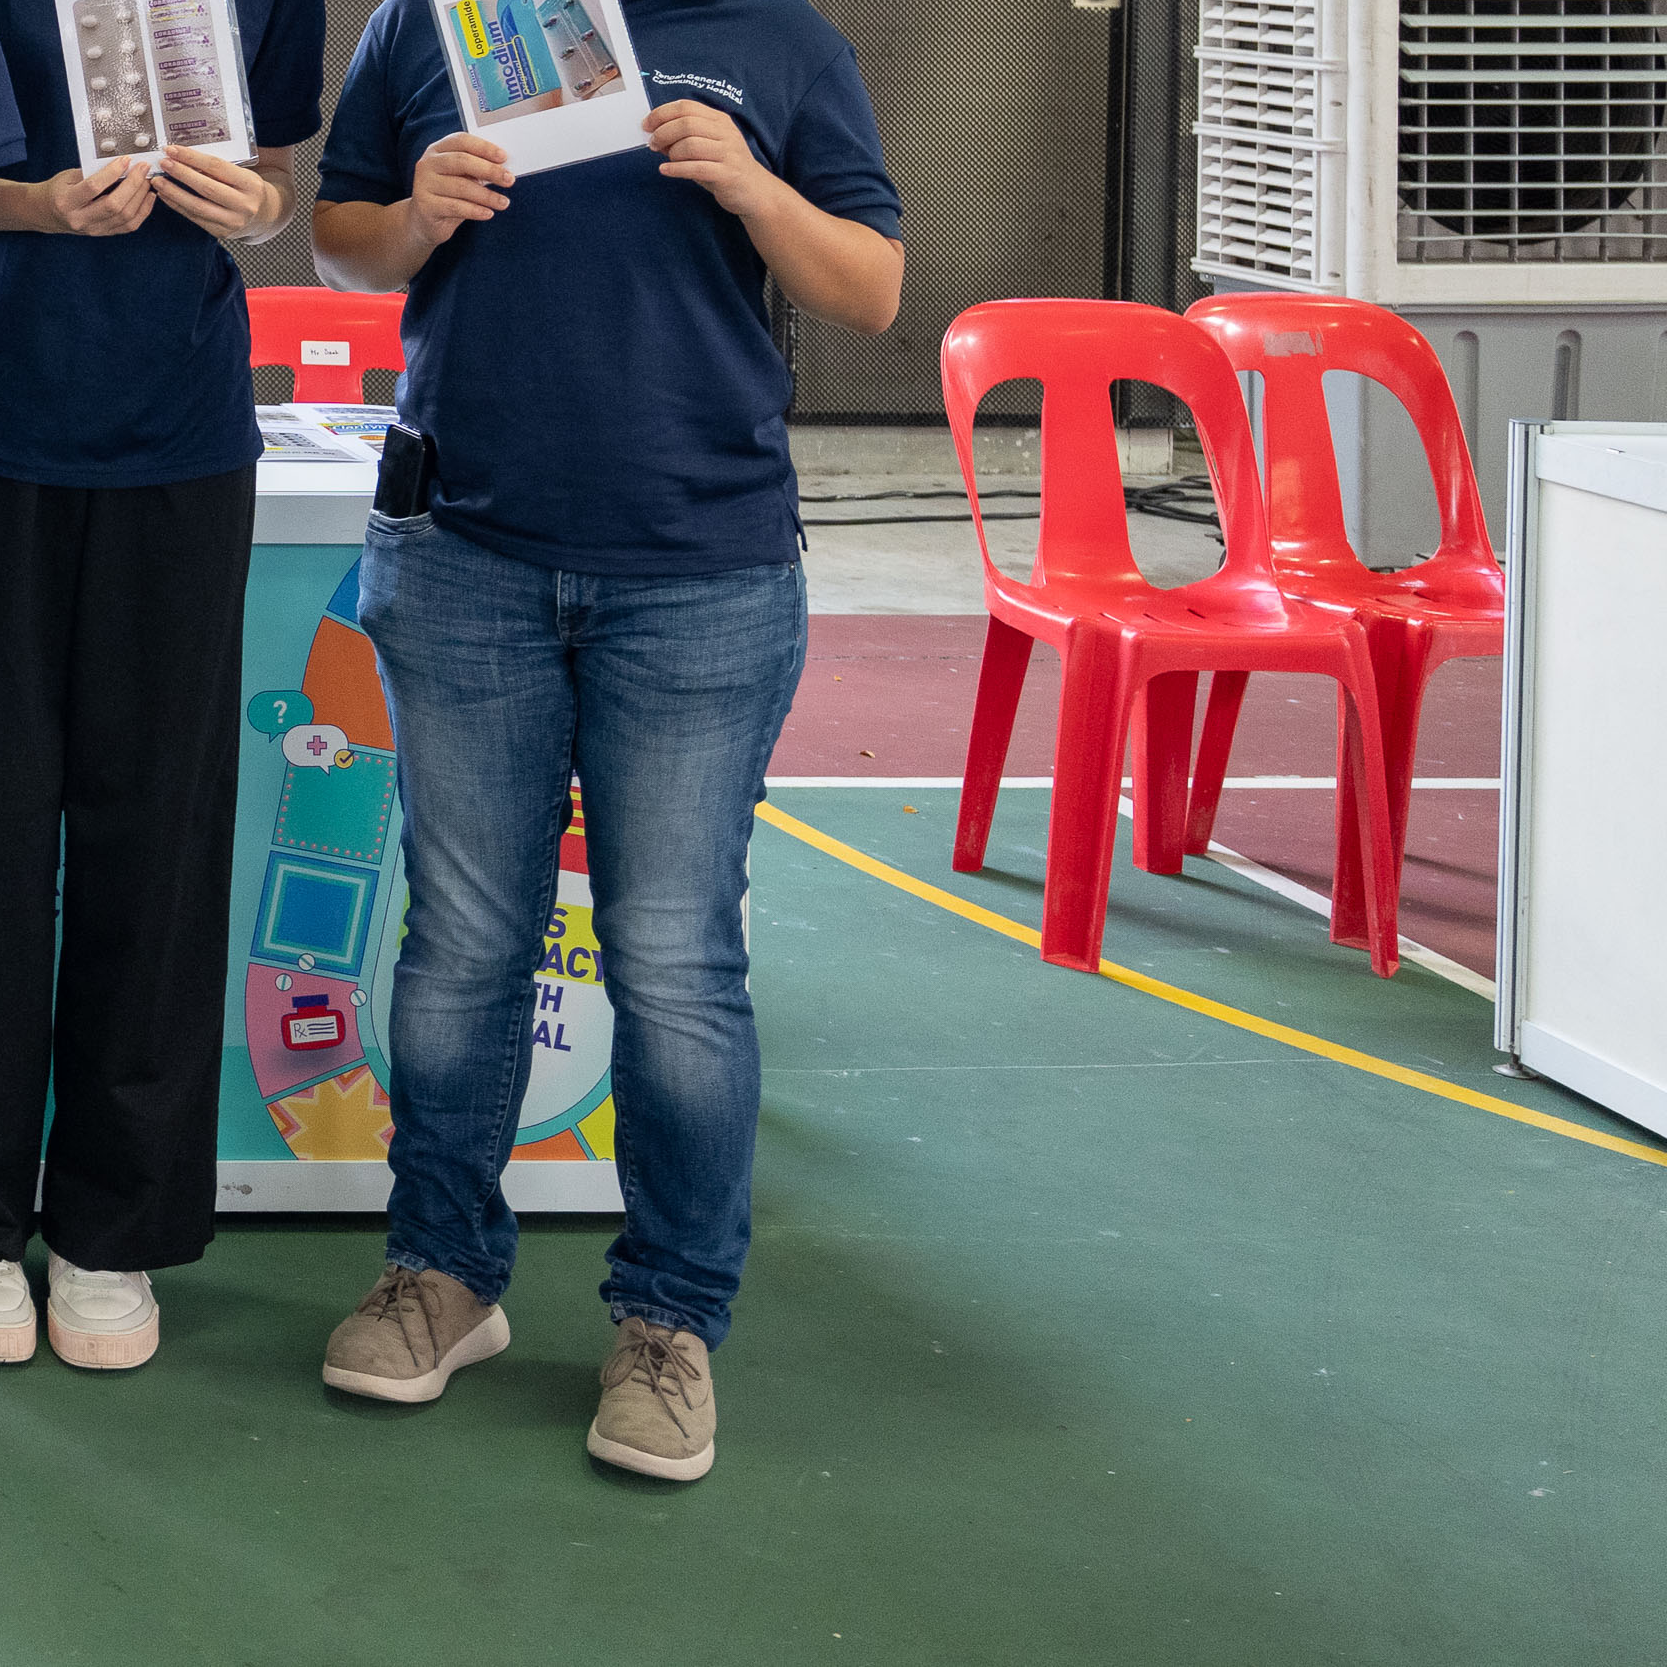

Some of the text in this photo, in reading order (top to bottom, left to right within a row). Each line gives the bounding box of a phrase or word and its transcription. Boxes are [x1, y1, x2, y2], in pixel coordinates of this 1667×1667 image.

[463, 1, 485, 56] Loperamide
[487, 21, 521, 101] Imodium
[652, 76, 743, 105] Community Hospital
[686, 73, 726, 88] General
[726, 83, 743, 97] and
